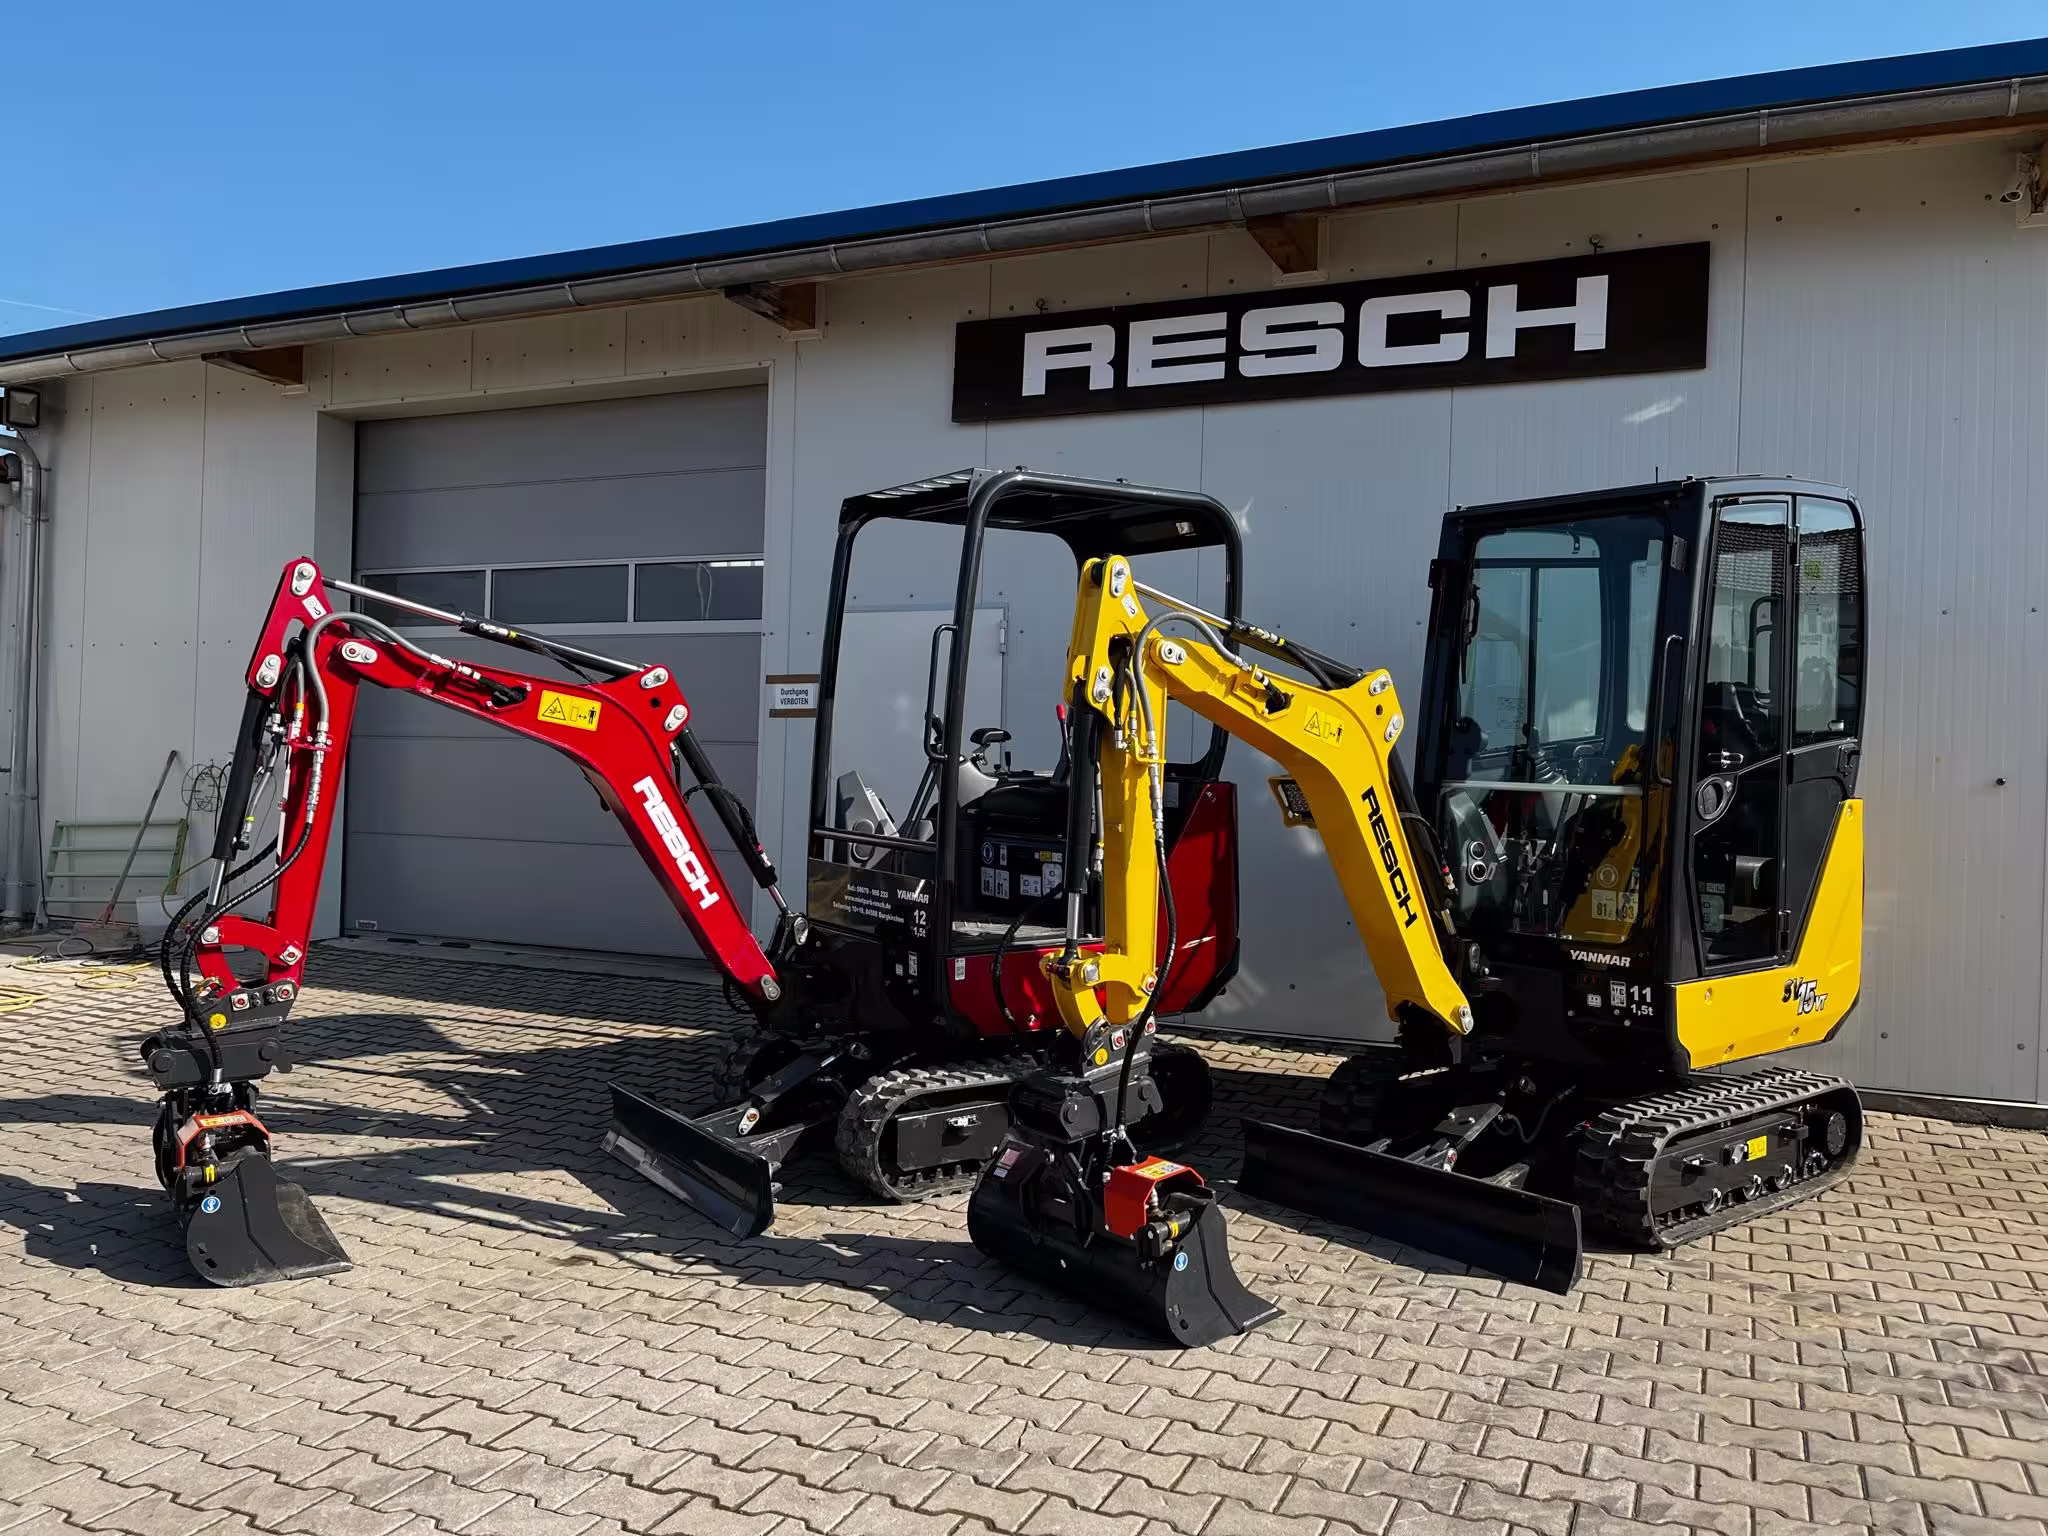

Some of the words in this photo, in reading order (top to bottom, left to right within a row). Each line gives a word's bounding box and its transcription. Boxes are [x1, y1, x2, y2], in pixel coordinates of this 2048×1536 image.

[1022, 274, 1609, 396] RESCH
[780, 687, 809, 697] Durchgang
[780, 697, 809, 705] VERBOTEN
[632, 775, 720, 910] RESCH
[1361, 785, 1418, 929] RESCH
[896, 888, 929, 904] YANMAR
[913, 909, 927, 926] 12
[913, 926, 926, 938] 1,5t
[1569, 949, 1631, 968] YANMAR
[1630, 985, 1652, 1003] 11
[1630, 1003, 1654, 1016] 1,5t
